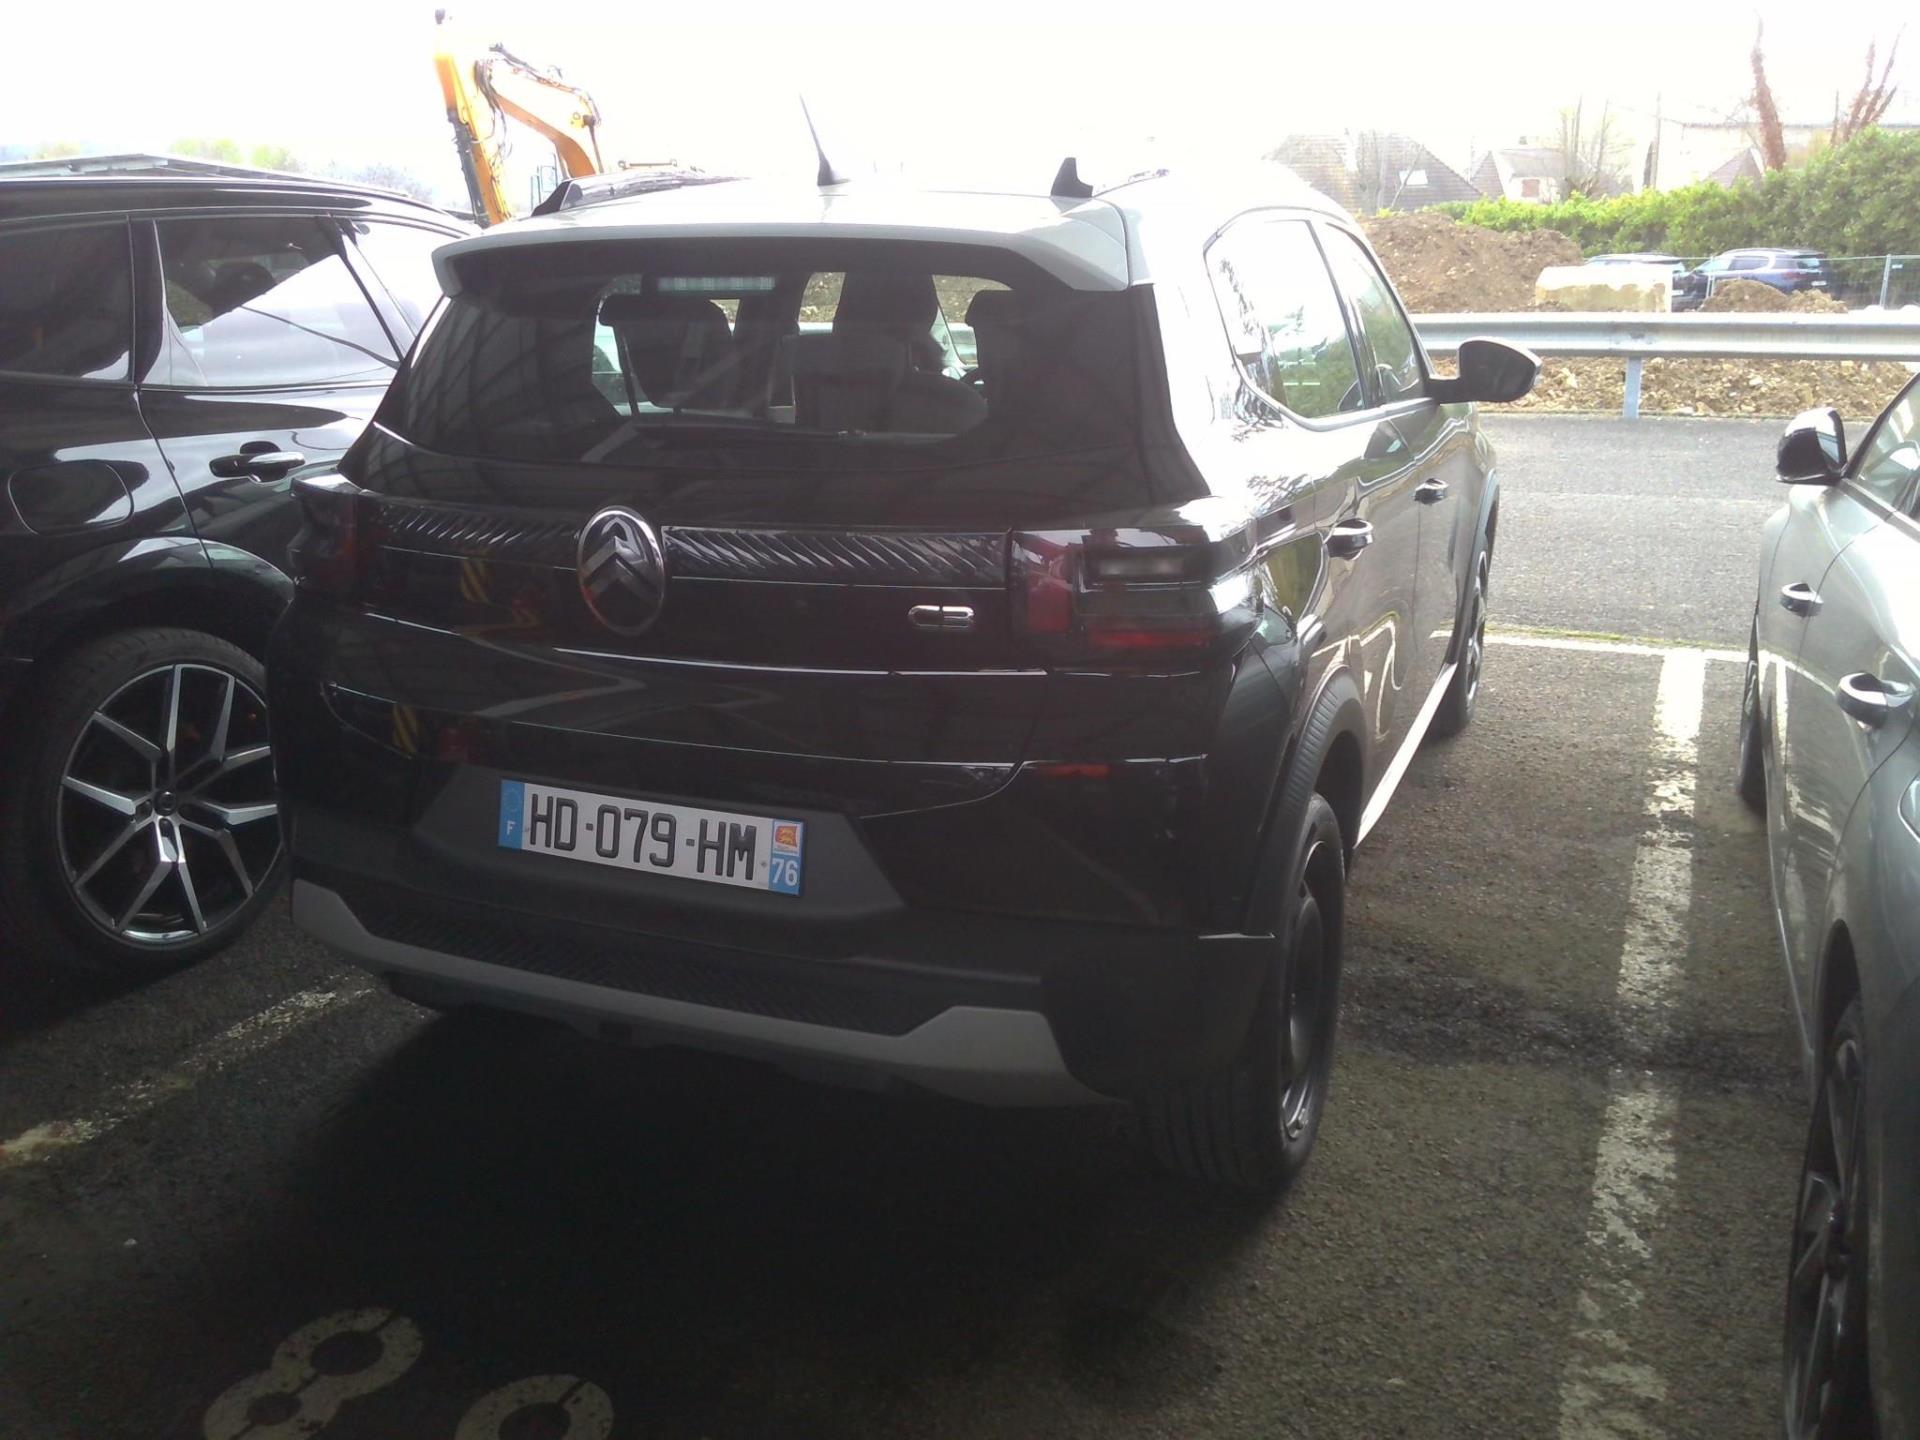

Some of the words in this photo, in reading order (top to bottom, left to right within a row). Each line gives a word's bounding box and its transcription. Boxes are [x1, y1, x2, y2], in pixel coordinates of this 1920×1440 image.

[506, 820, 516, 835] F
[529, 793, 757, 881] HD-079-HM
[772, 857, 799, 887] 76
